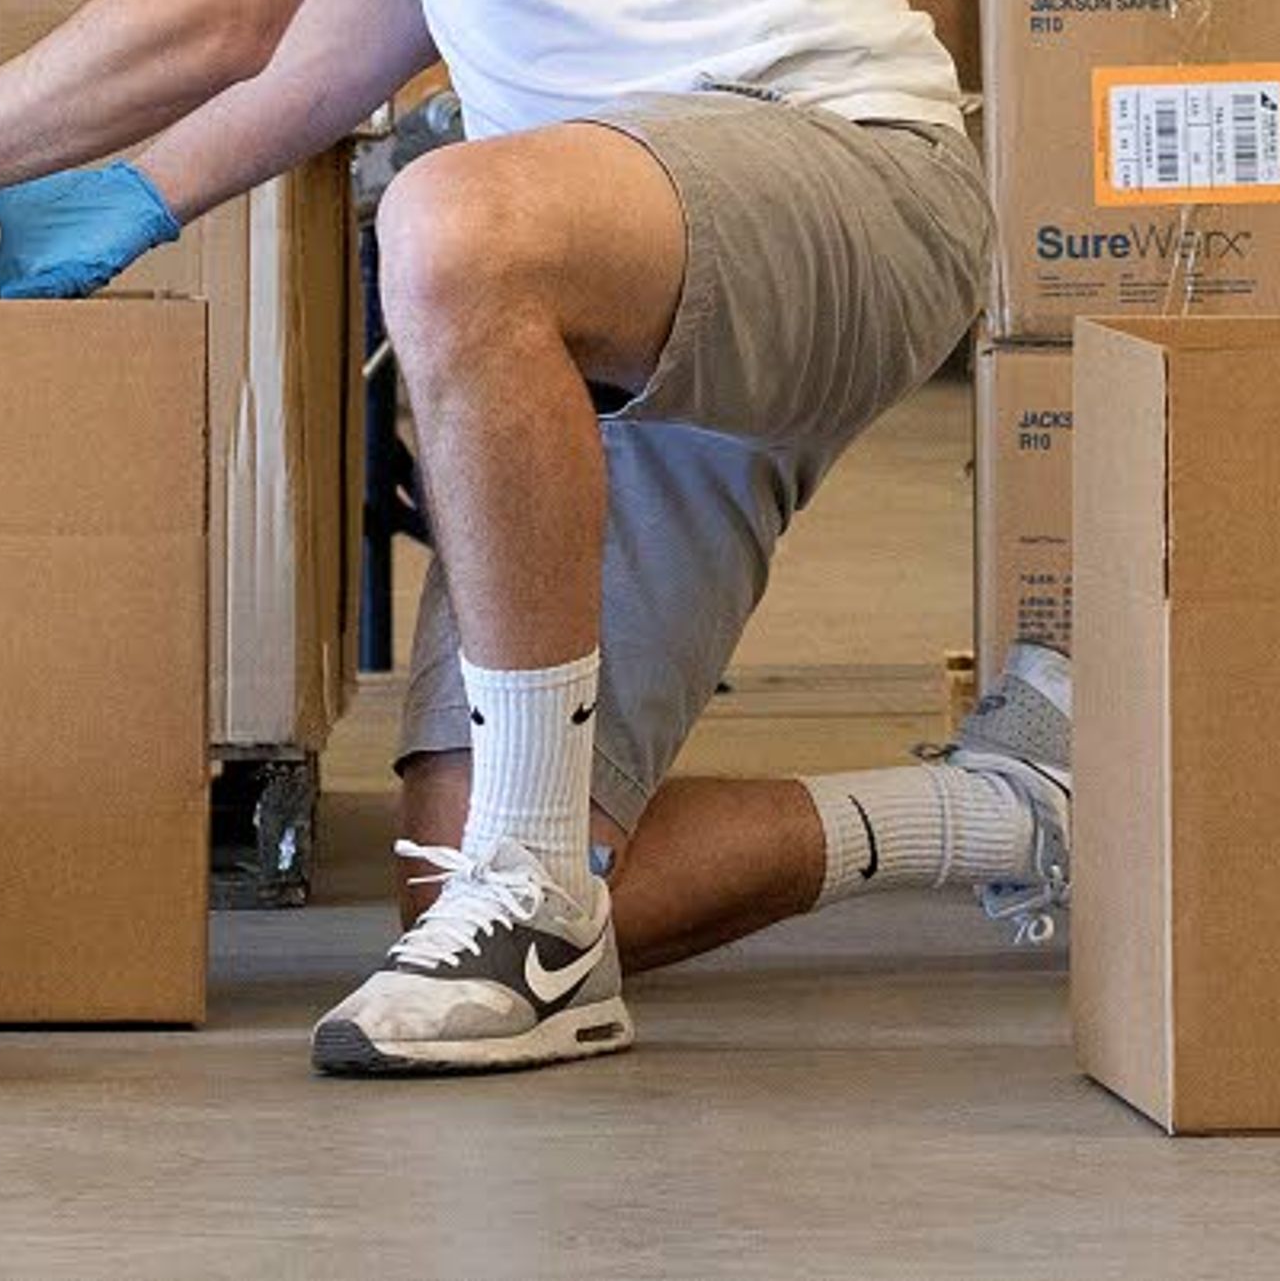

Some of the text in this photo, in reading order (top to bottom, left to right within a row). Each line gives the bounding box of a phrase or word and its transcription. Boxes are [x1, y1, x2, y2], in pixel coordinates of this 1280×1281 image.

[1031, 16, 1063, 33] R10
[1019, 411, 1073, 428] JACKS
[1020, 433, 1052, 450] R10
